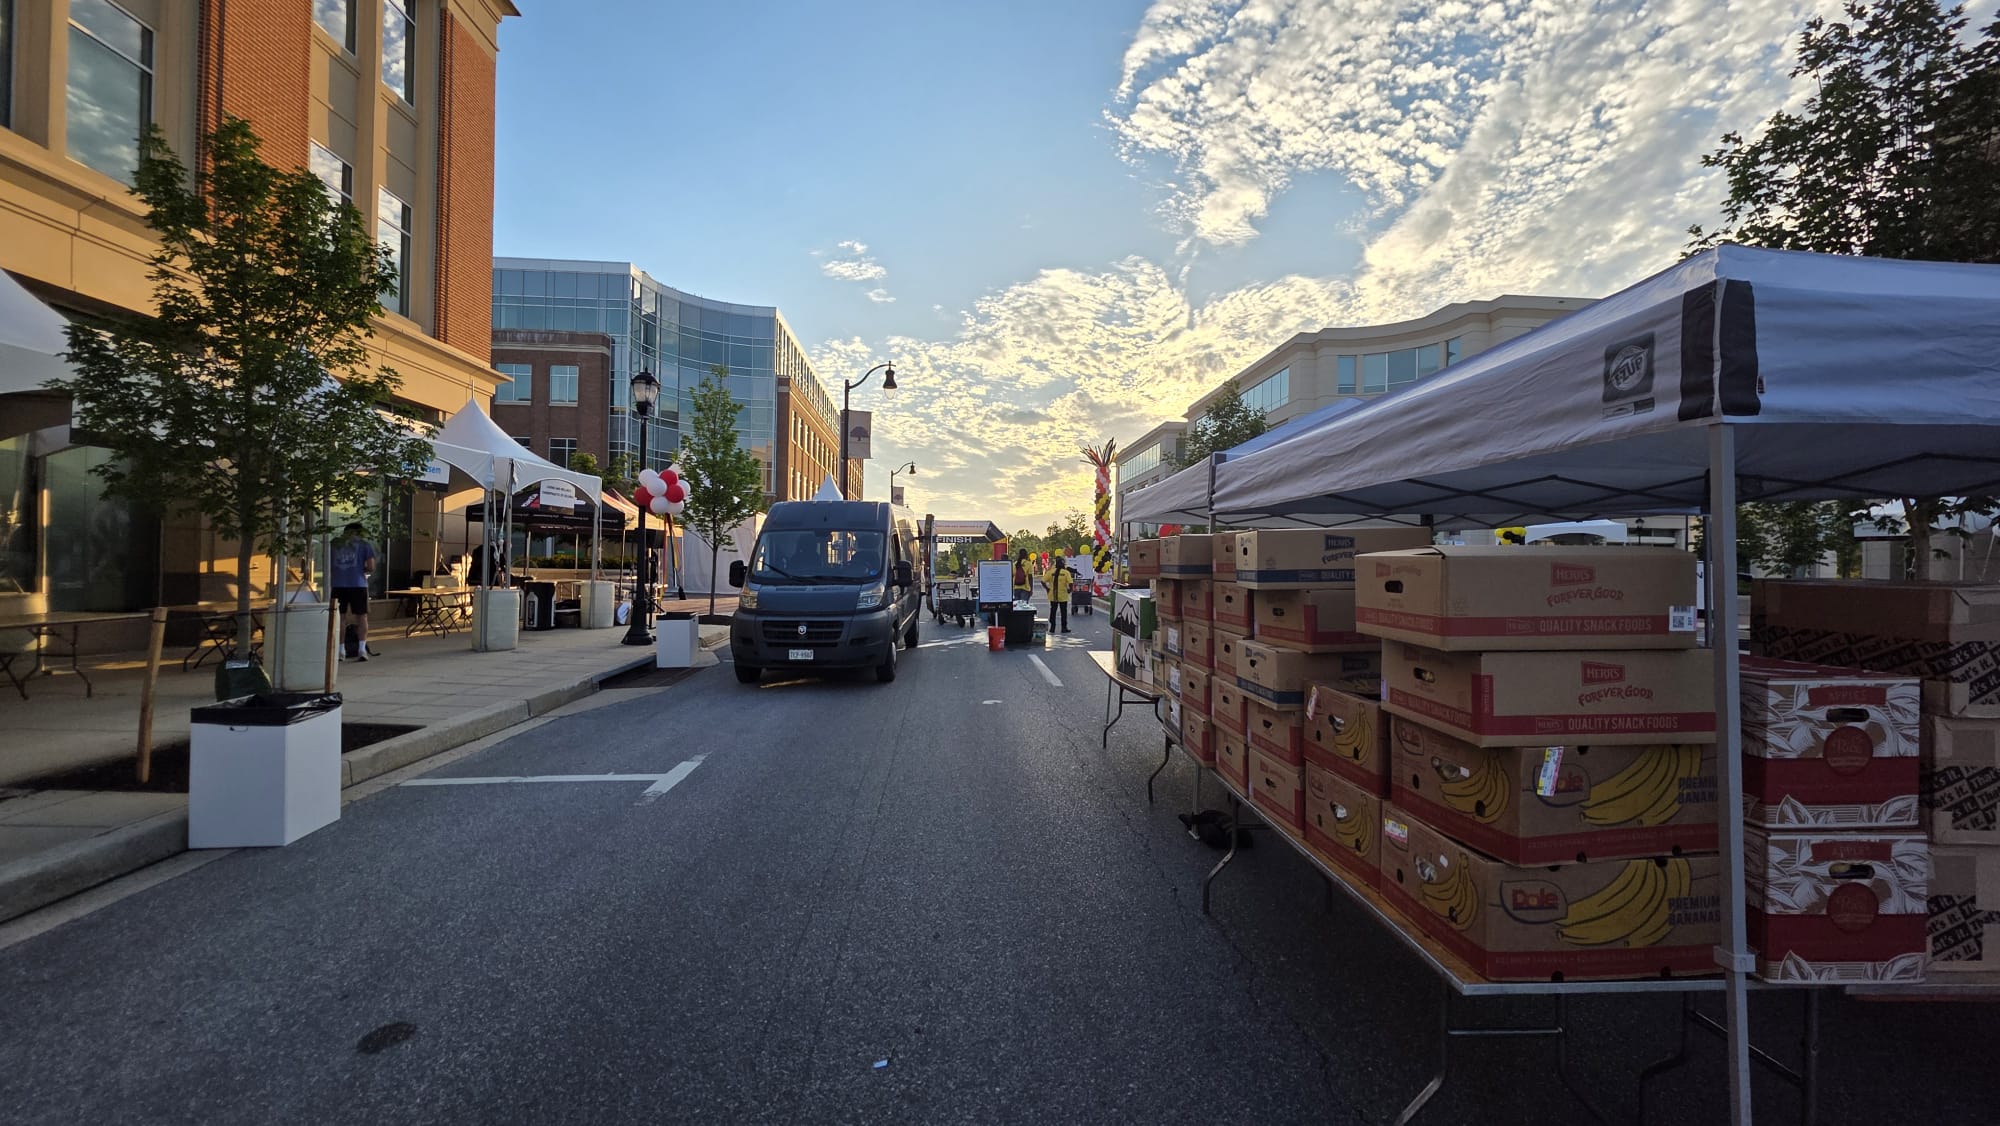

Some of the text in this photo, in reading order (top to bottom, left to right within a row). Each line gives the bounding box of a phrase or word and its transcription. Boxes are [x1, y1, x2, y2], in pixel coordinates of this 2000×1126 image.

[1546, 586, 1624, 607] FOREVER GOOD
[1540, 618, 1582, 632] QUALITY
[1583, 617, 1618, 631] SNACK
[1618, 616, 1652, 631] FOODS
[1578, 684, 1653, 706] FOREVER GOOD
[1568, 718, 1610, 730] QUALITY
[1611, 717, 1646, 729] SNACK
[1647, 716, 1679, 729] FOODS
[1679, 776, 1718, 789] PREMIU
[1513, 888, 1558, 906] Dole
[1668, 896, 1720, 910] PREMIUM
[1668, 911, 1720, 926] BANANAS
